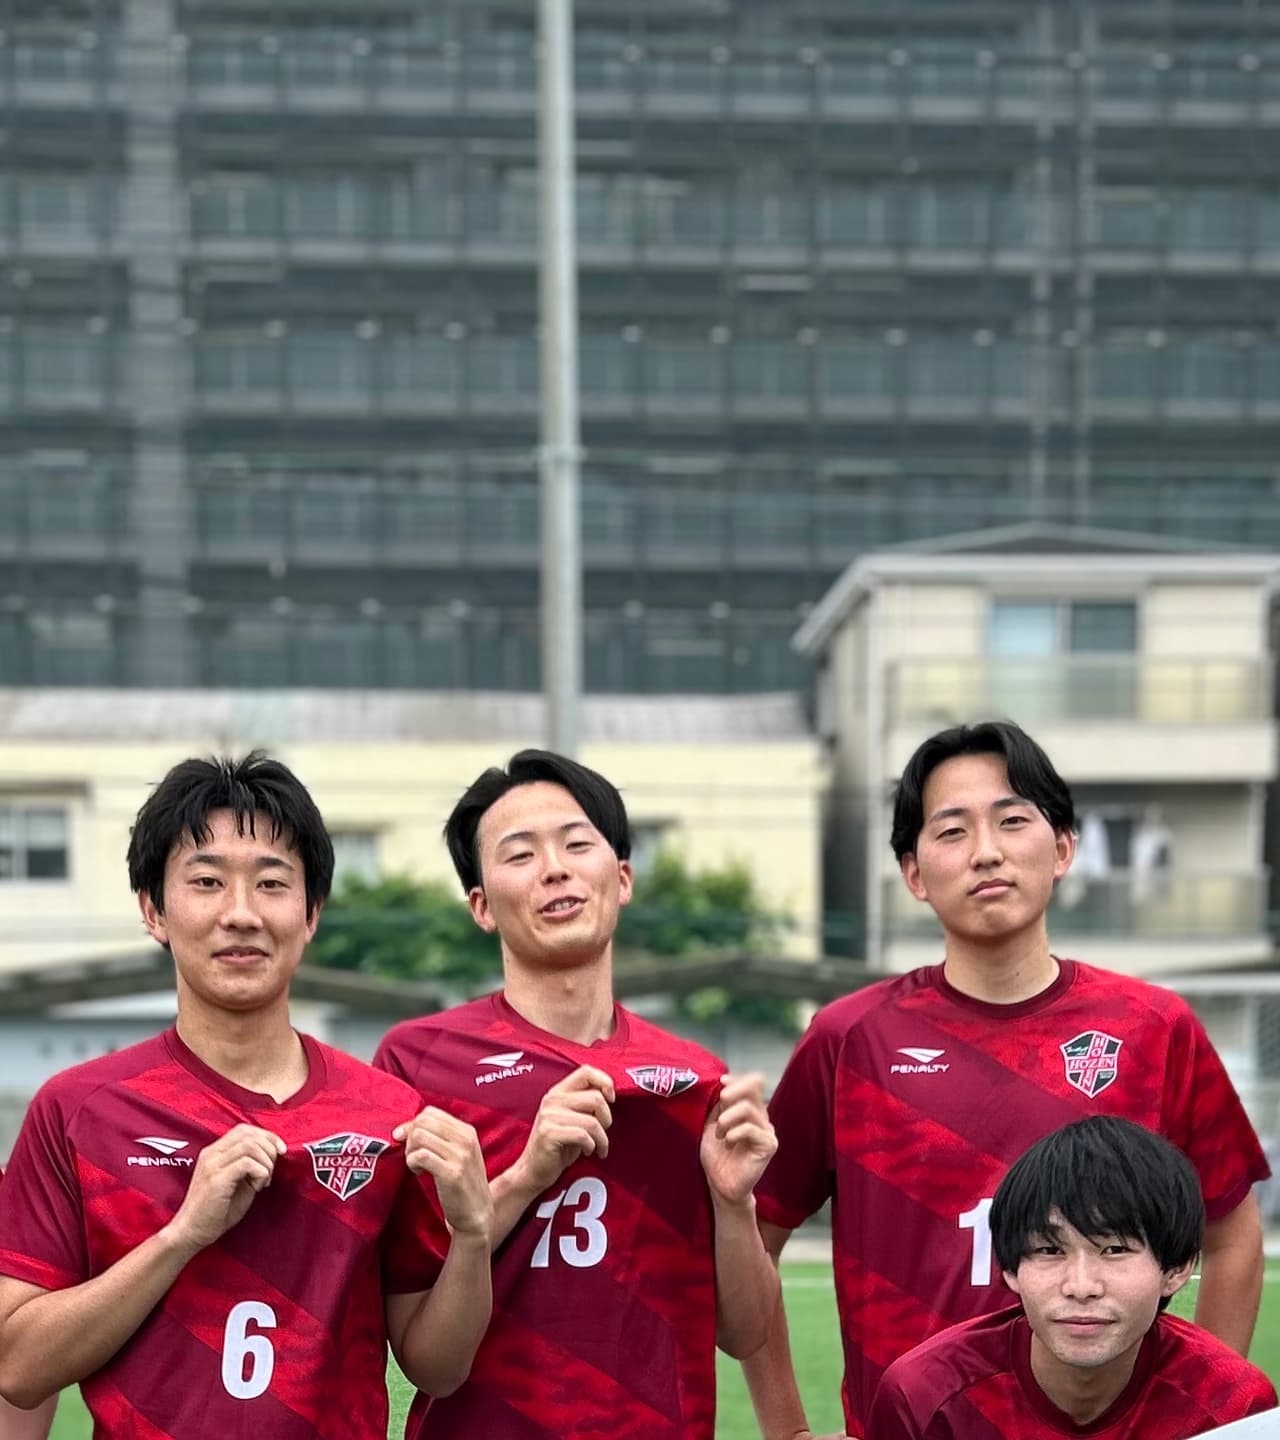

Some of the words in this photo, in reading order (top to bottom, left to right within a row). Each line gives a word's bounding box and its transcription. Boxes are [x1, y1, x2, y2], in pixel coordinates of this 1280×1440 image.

[890, 1063, 950, 1074] PENALTY
[1069, 1058, 1115, 1071] HOZEN
[475, 1063, 534, 1087] PENALTY
[126, 1156, 195, 1168] PENALTY
[317, 1155, 374, 1168] HOZEN
[221, 1300, 277, 1400] 6
